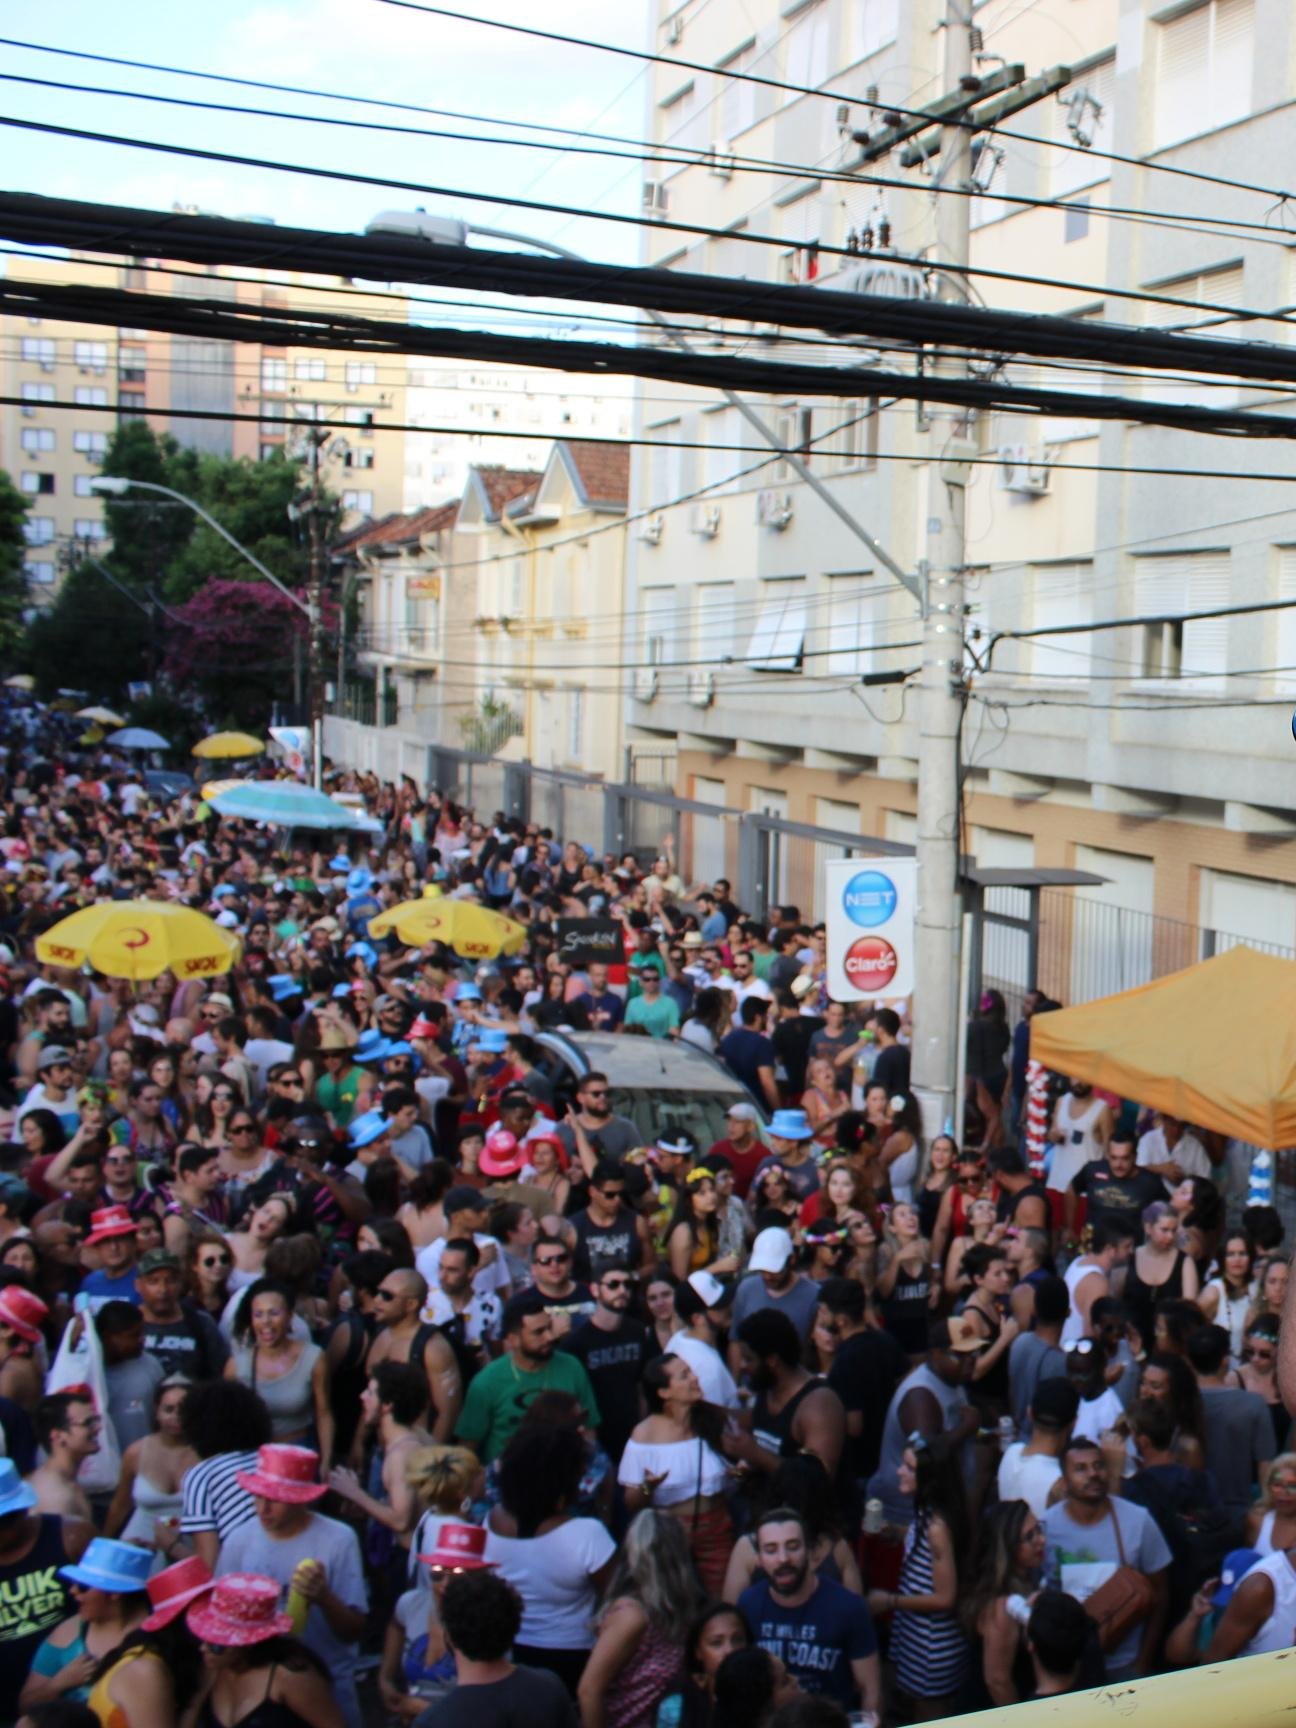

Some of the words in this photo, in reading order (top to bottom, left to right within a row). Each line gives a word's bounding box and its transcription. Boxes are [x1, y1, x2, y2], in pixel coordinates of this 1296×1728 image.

[846, 890, 895, 907] NET
[845, 953, 891, 973] Claro
[0, 1565, 62, 1604] UIK
[787, 1640, 843, 1671] COAST
